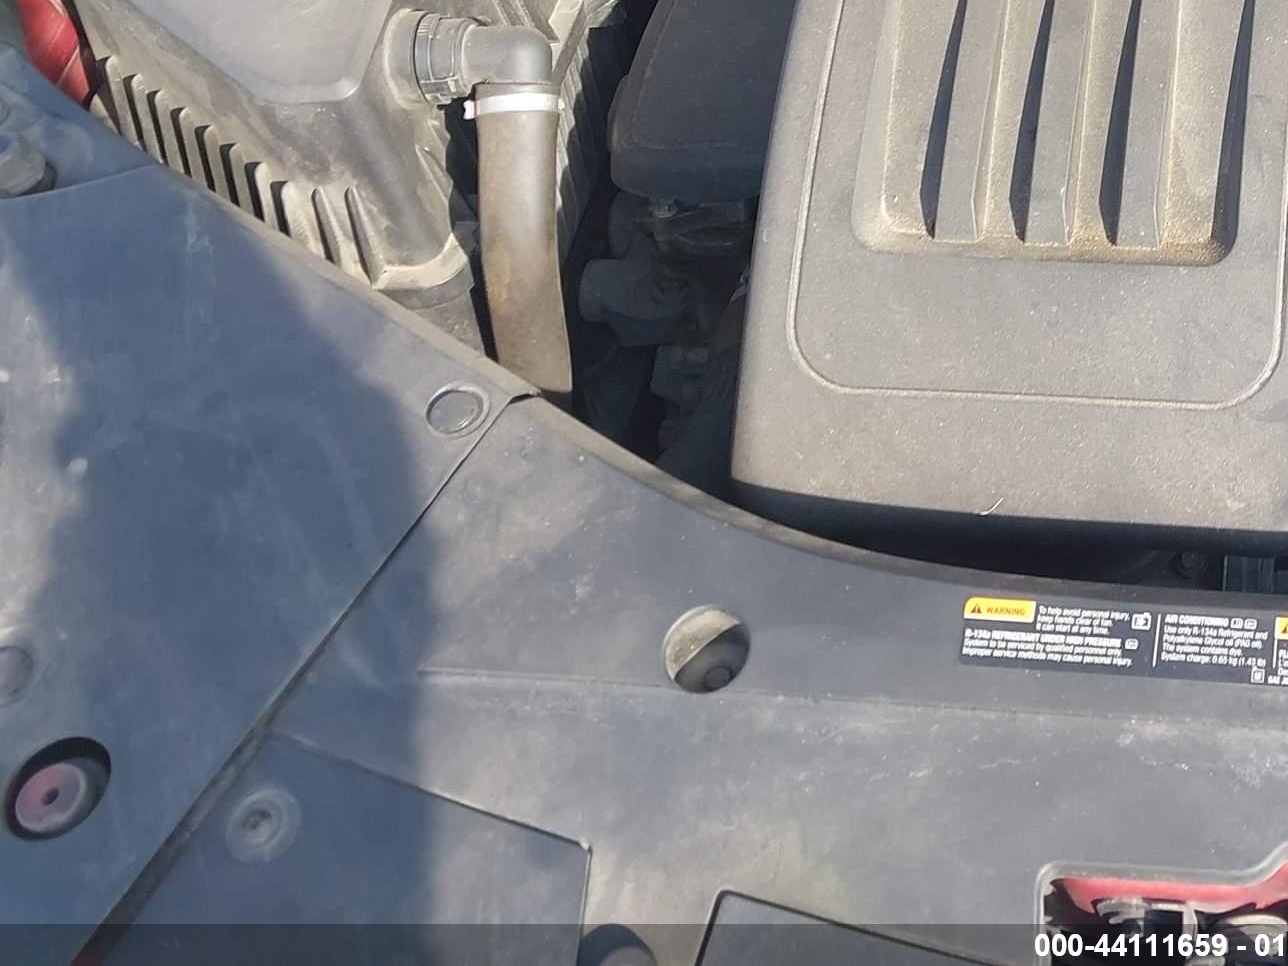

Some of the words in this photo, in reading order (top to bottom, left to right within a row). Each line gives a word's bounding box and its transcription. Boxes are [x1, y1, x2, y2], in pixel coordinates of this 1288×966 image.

[986, 607, 1025, 616] WARNING
[1039, 606, 1047, 614] To
[1048, 607, 1061, 617] help
[1063, 608, 1079, 617] avoid
[1080, 610, 1110, 619] personal
[1037, 615, 1053, 624] keep
[1055, 616, 1074, 624] hands
[1075, 617, 1093, 625] clear
[1165, 614, 1178, 624] AIR
[1179, 615, 1229, 627] CONDITIONING
[1080, 627, 1091, 635] any
[1164, 625, 1177, 634] Use
[1178, 626, 1191, 636] only
[1193, 627, 1217, 637] R-134a
[1218, 629, 1254, 640] Refrigerant
[1255, 631, 1268, 640] and
[965, 629, 990, 639] R-134a
[992, 630, 1039, 642] REFRIGERANT
[1041, 634, 1065, 644] UNDER
[1066, 636, 1083, 645] HIGH
[1084, 637, 1121, 647] PRESSURE
[1225, 638, 1233, 647] oil
[964, 639, 988, 647] System
[1008, 642, 1037, 650] serviced
[1038, 644, 1044, 652] by
[1045, 644, 1073, 654] qualified
[1074, 646, 1106, 655] personnel
[1163, 643, 1175, 652] The
[1176, 644, 1199, 654] system
[1200, 646, 1228, 655] contains
[1229, 648, 1243, 657] dye.
[962, 647, 991, 657] Improper
[993, 649, 1016, 658] service
[1018, 651, 1046, 660] methods
[1048, 654, 1061, 662] may
[1063, 654, 1082, 662] cause
[1084, 655, 1112, 665] personal
[1161, 652, 1185, 663] System
[1229, 657, 1237, 666] kg
